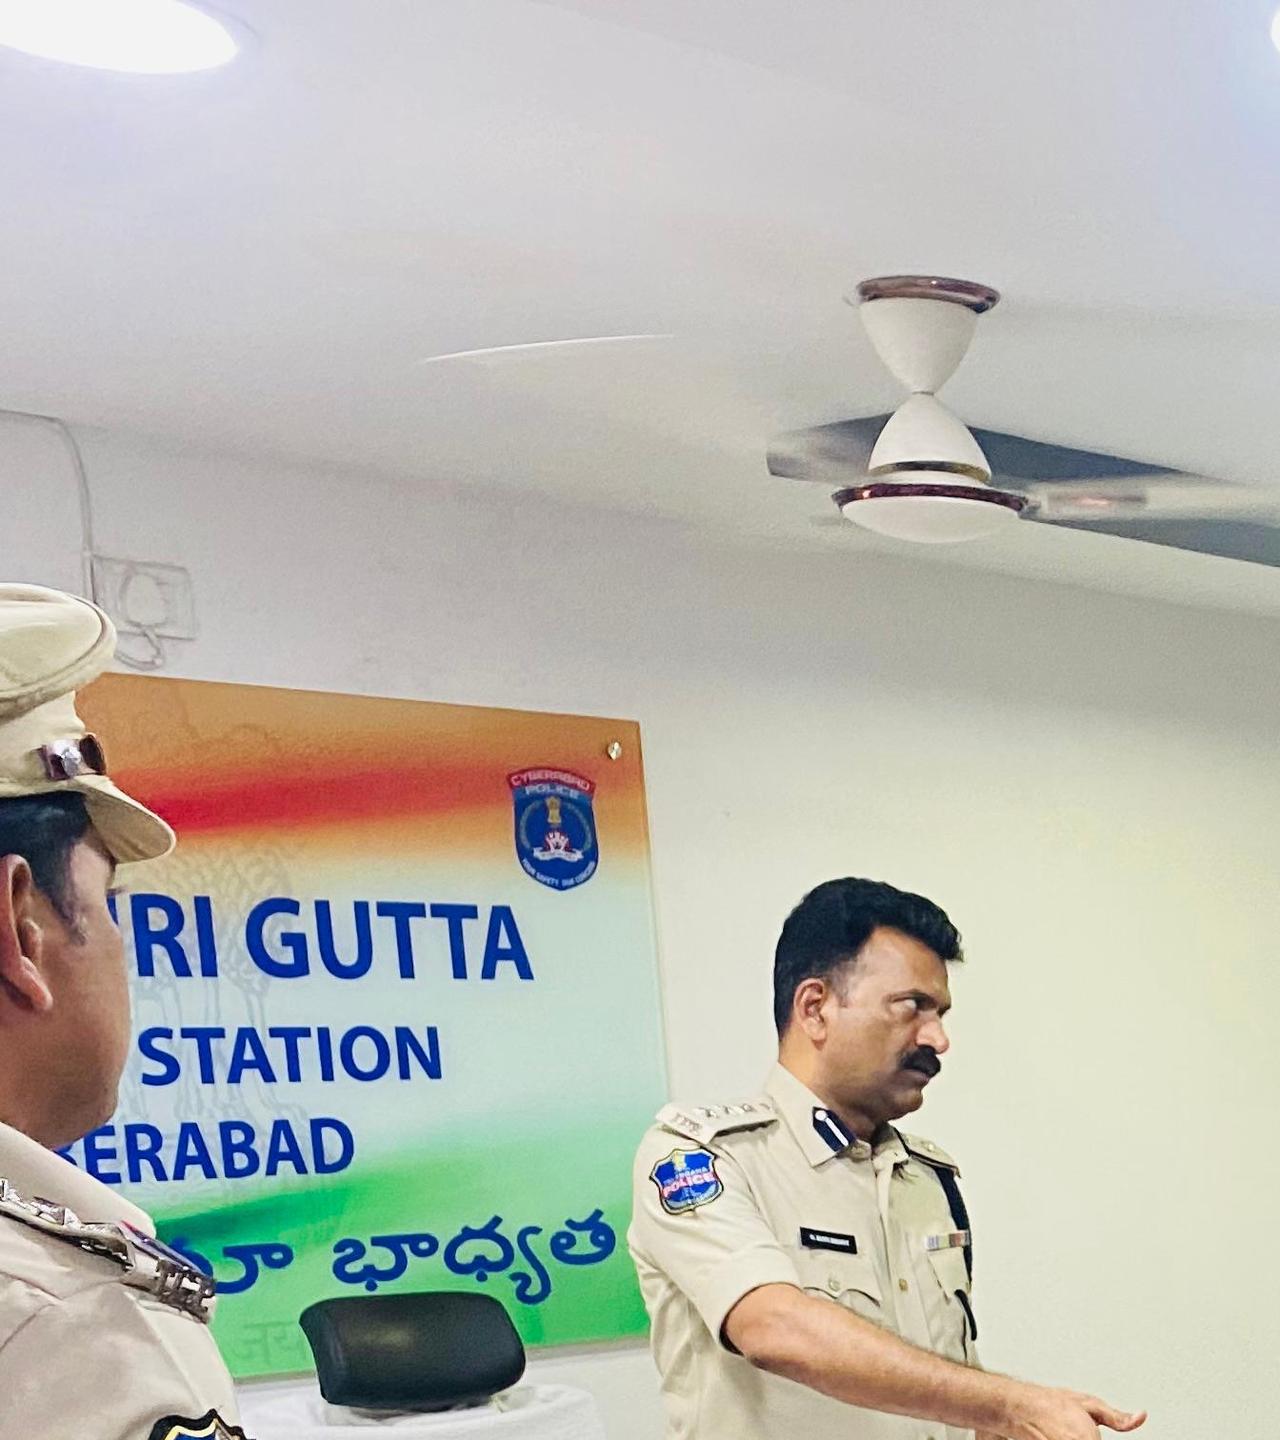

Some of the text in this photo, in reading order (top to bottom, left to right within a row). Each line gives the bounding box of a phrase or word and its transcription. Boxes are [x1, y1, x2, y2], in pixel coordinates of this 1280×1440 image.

[109, 894, 535, 981] RI GUTTA
[140, 1025, 443, 1087] STATION
